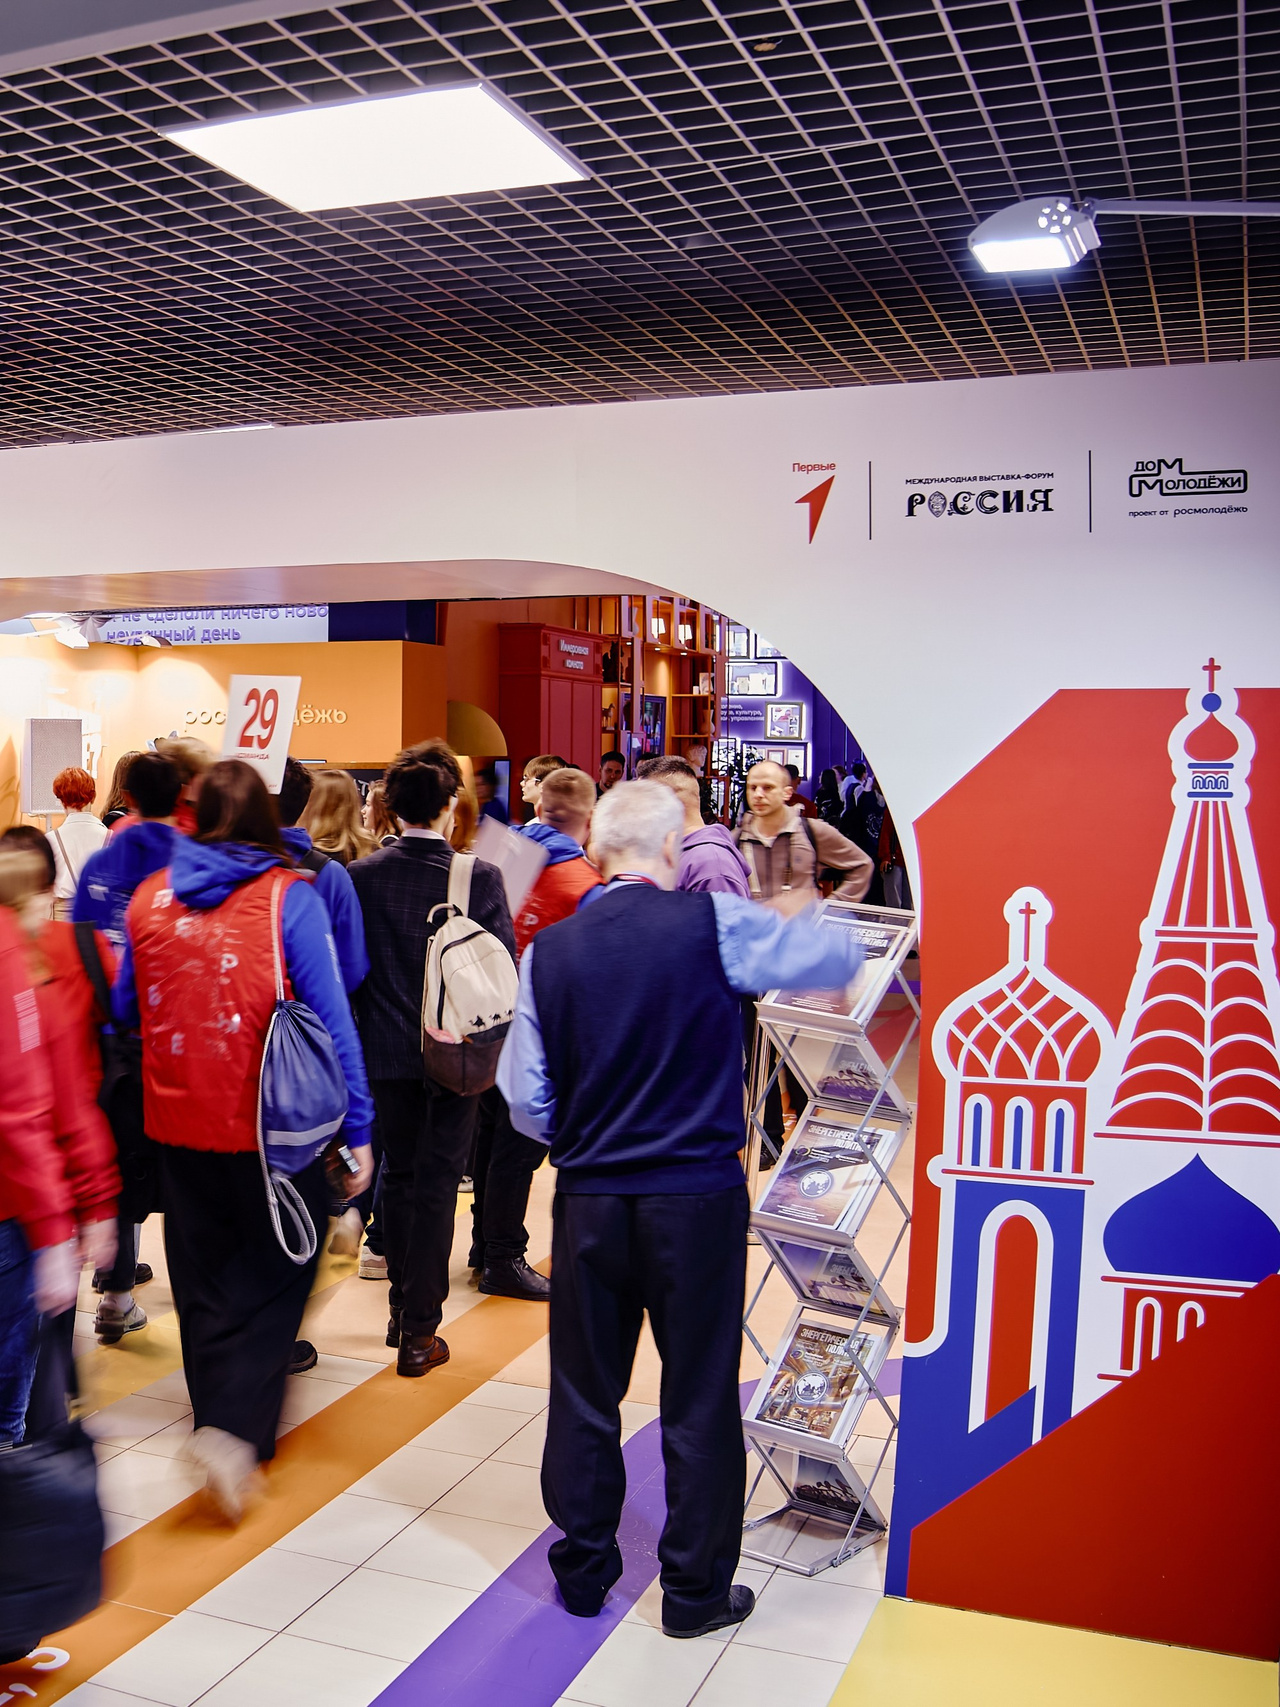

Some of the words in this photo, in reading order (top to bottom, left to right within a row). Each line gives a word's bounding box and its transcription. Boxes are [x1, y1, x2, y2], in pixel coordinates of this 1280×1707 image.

[792, 461, 836, 475] Первые
[905, 475, 978, 485] МЕЖДУНАРОДНАЯ
[979, 472, 1054, 482] ВЫСТАВКА-ФОРУМ
[905, 488, 1054, 518] РОССИЯ
[1173, 505, 1248, 518] росмолодёжь
[200, 628, 242, 643] день
[237, 687, 280, 750] 29
